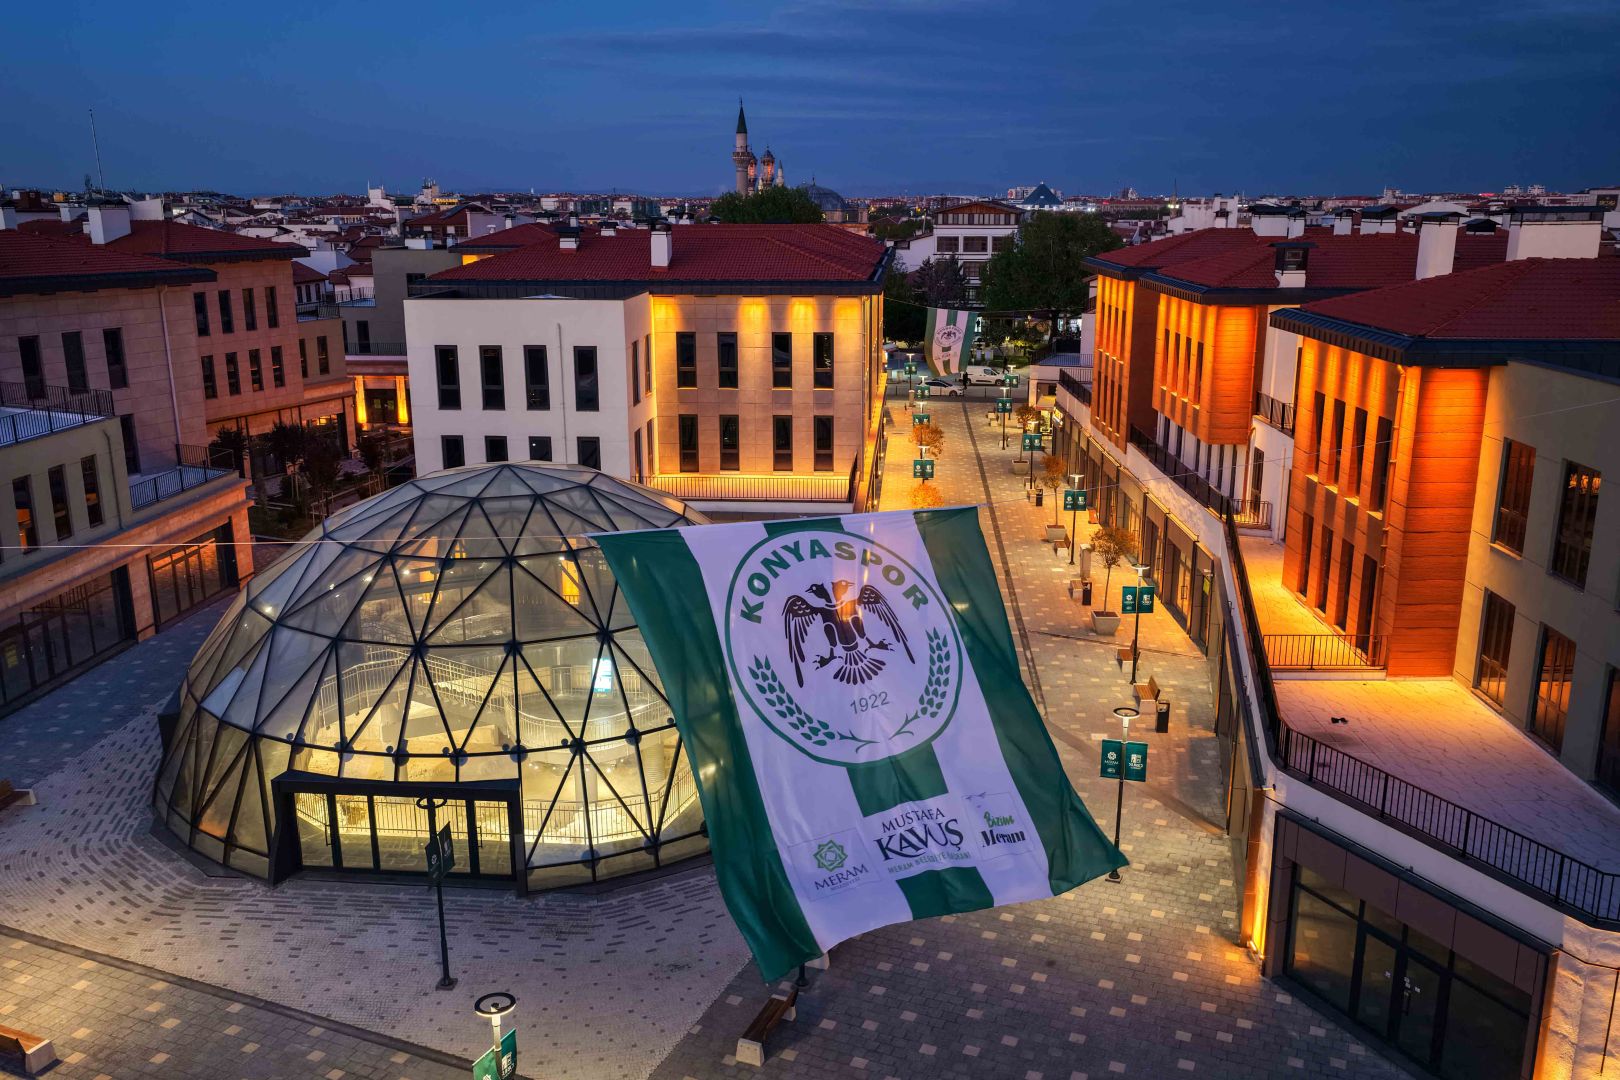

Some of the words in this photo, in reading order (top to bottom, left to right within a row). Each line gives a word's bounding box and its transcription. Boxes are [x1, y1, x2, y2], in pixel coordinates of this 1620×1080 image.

[740, 538, 929, 624] KONYASPOR
[850, 691, 890, 715] 1922
[882, 808, 945, 834] MUSTAFA
[873, 818, 964, 861] KAVUŞ
[981, 829, 1026, 848] Meram
[814, 863, 869, 890] MERAM
